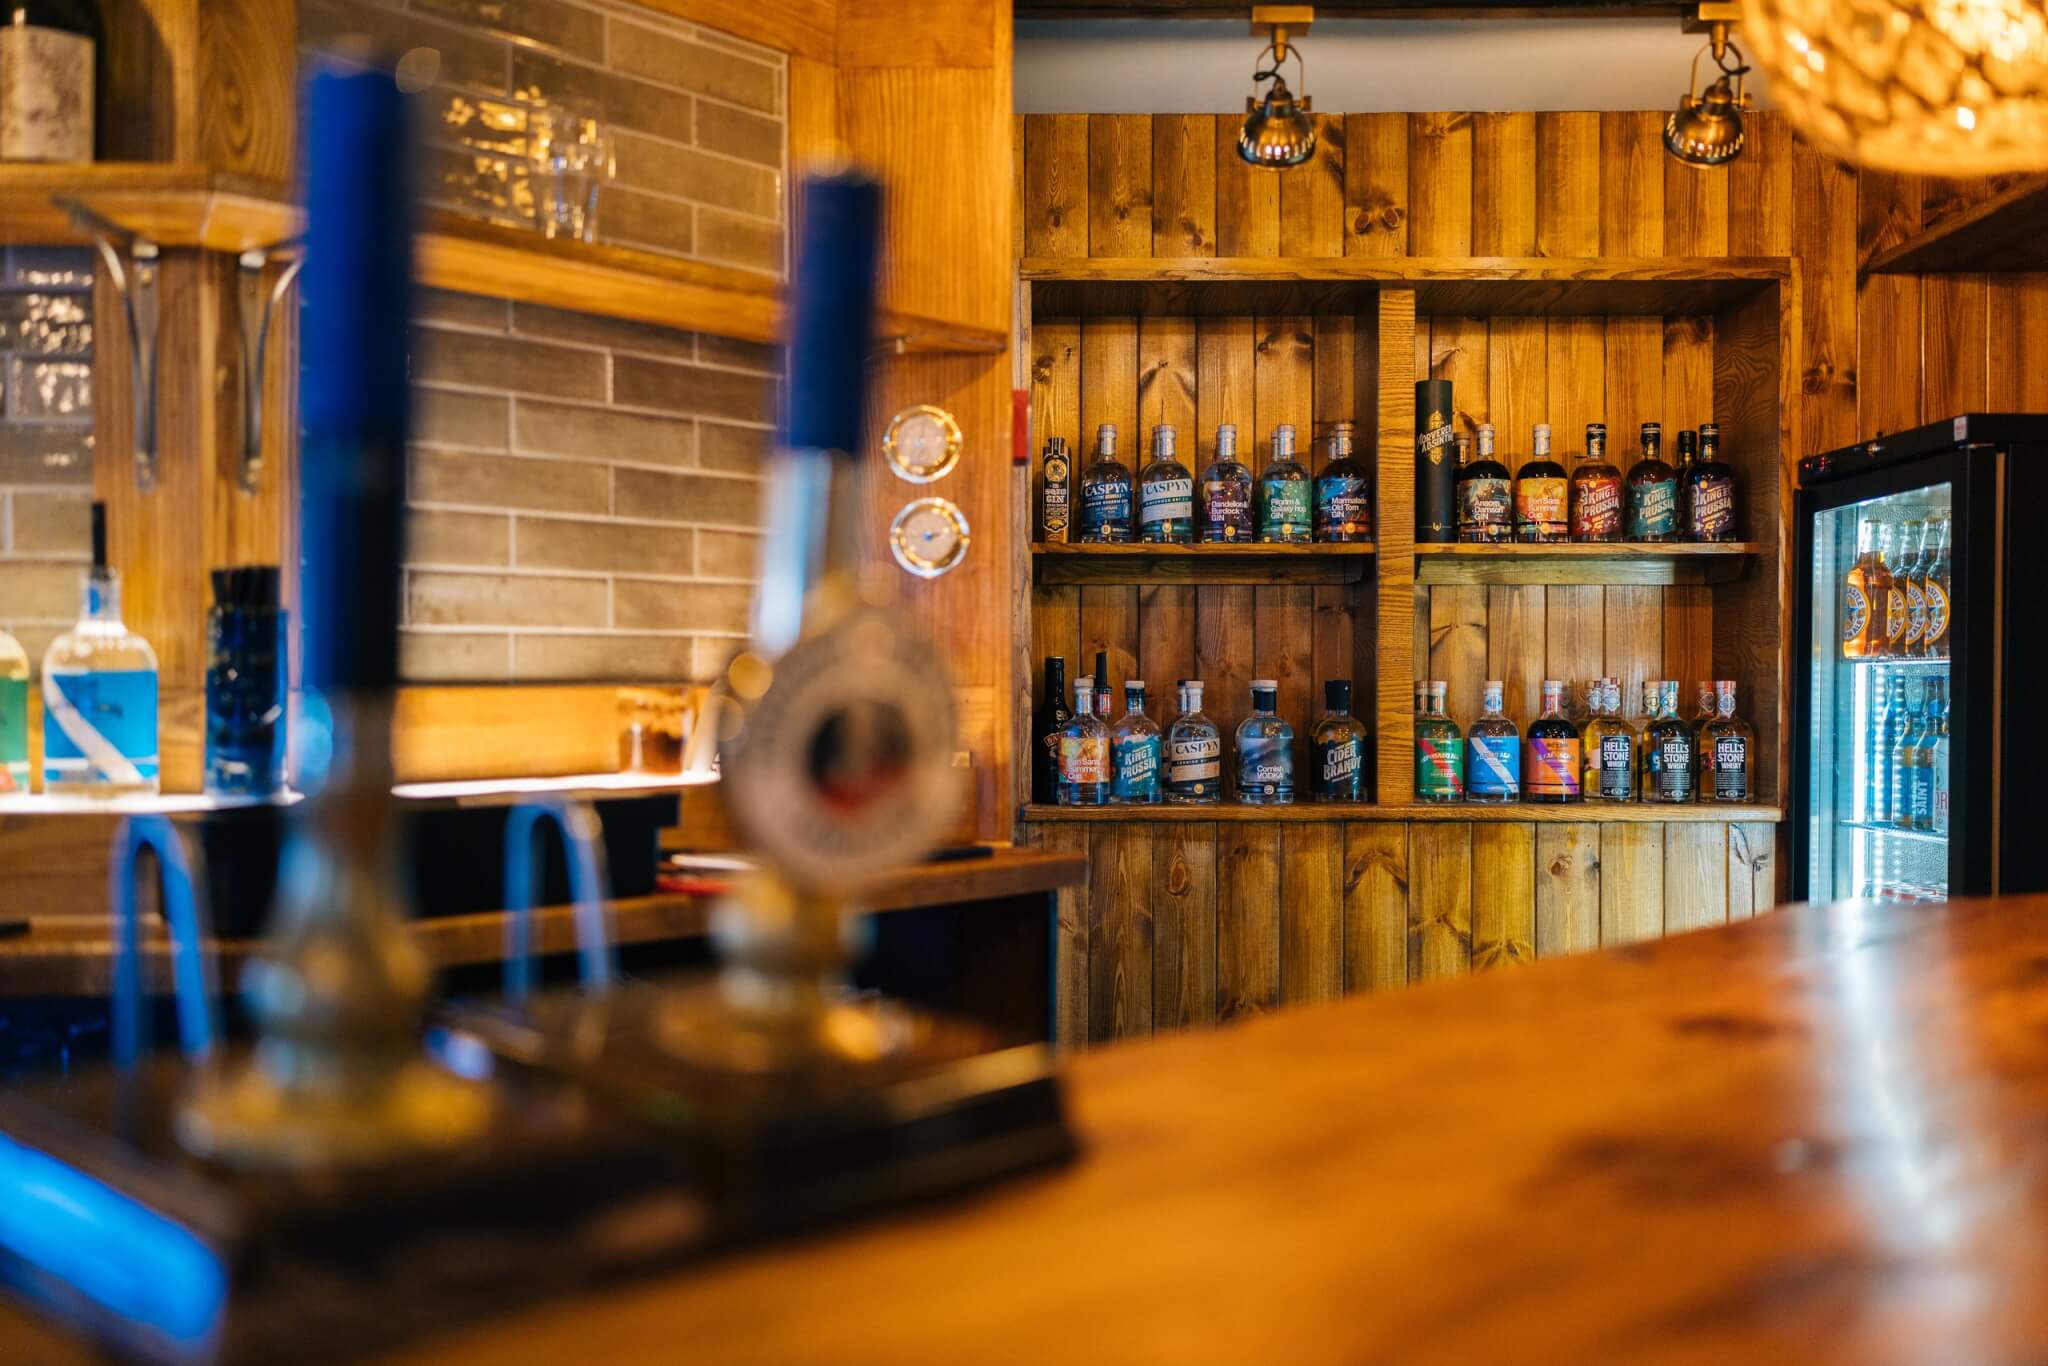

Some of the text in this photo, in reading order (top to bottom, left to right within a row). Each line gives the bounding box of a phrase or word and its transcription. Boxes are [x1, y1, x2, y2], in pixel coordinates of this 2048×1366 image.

[1085, 482, 1128, 497] CASPYN
[1146, 480, 1189, 495] CASPYN
[1588, 489, 1610, 505] KING
[1644, 490, 1665, 506] KING
[1700, 488, 1721, 505] KING
[1584, 496, 1619, 518] PRUSSIA
[1640, 498, 1674, 519] PRUSSIA
[1696, 496, 1732, 519] PRUSSIA
[1176, 741, 1217, 755] CASPYN
[1603, 741, 1629, 751] HELL'S
[1664, 743, 1689, 753] HELL'S
[1717, 743, 1744, 753] HELL'S
[1125, 749, 1146, 766] KING
[1327, 744, 1356, 766] CIDER
[1603, 752, 1629, 761] STONE
[1664, 753, 1689, 762] STONE
[1717, 753, 1744, 762] STONE
[1121, 757, 1157, 780] PRUSSIA
[1323, 756, 1361, 780] BRANDY
[1917, 781, 1928, 815] SAINT
